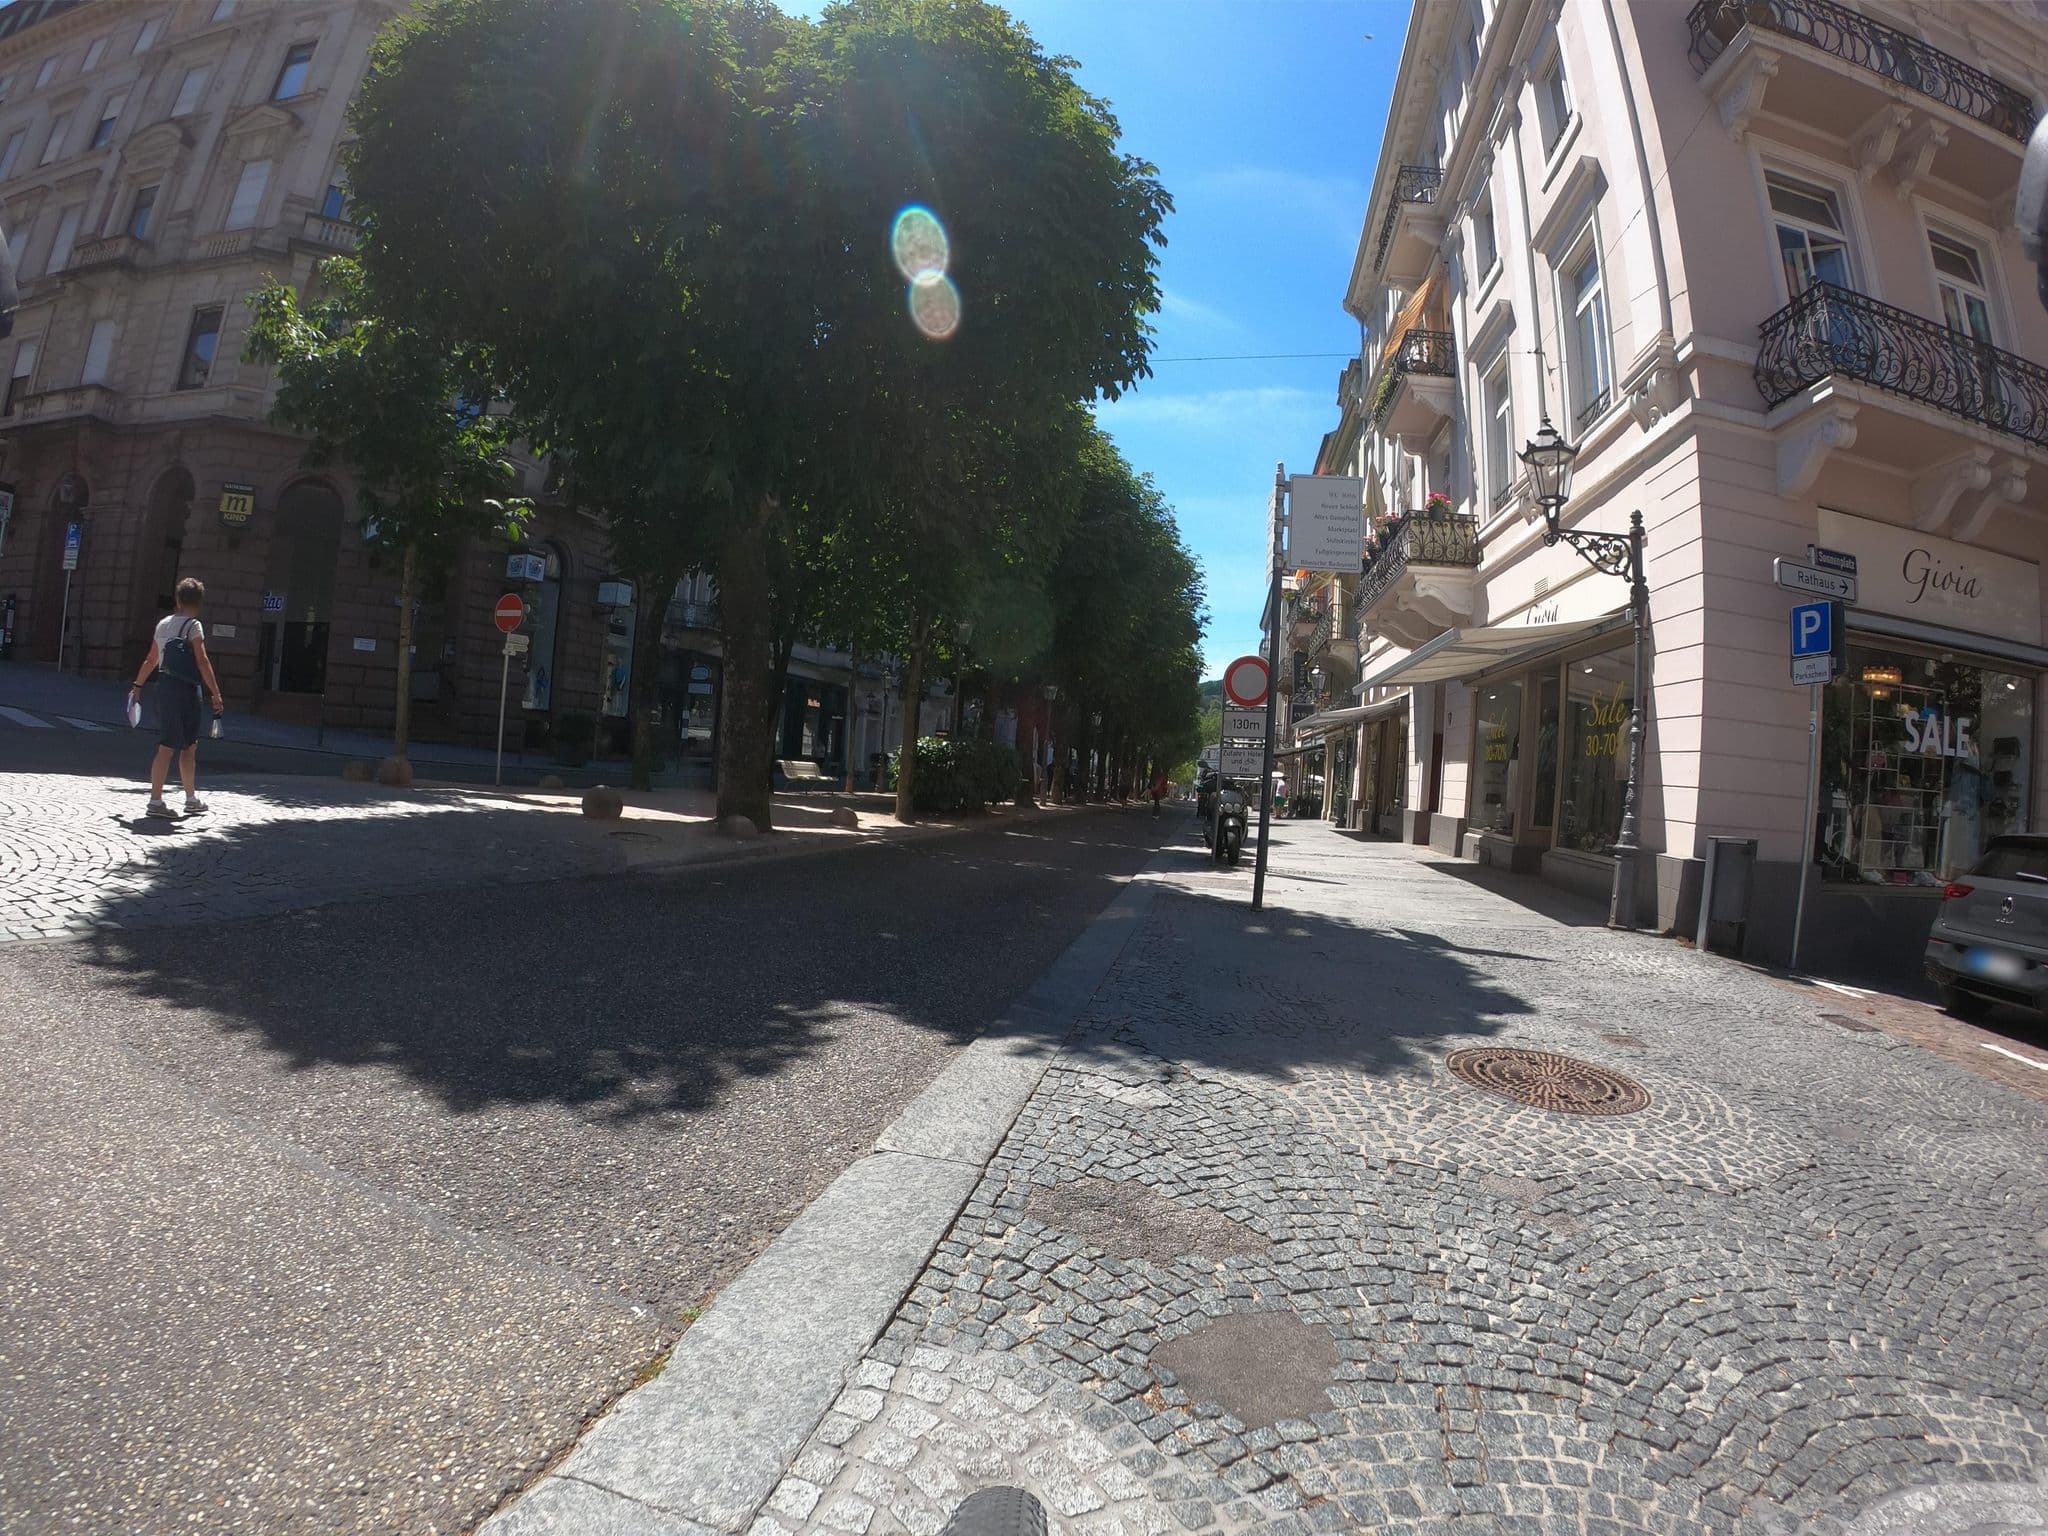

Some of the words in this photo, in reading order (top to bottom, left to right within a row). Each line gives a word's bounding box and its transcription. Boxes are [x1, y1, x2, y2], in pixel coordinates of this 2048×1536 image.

[224, 513, 247, 522] KINO
[1818, 550, 1855, 570] Sonnenplatz
[1797, 571, 1836, 590] Rathaus
[1903, 548, 1983, 604] Gioia
[1800, 610, 1821, 649] P
[1794, 671, 1828, 680] Parkschein
[1586, 680, 1626, 727] Sale
[1233, 718, 1260, 730] 130m
[1904, 710, 1971, 758] SALE
[1247, 750, 1263, 758] Hotel
